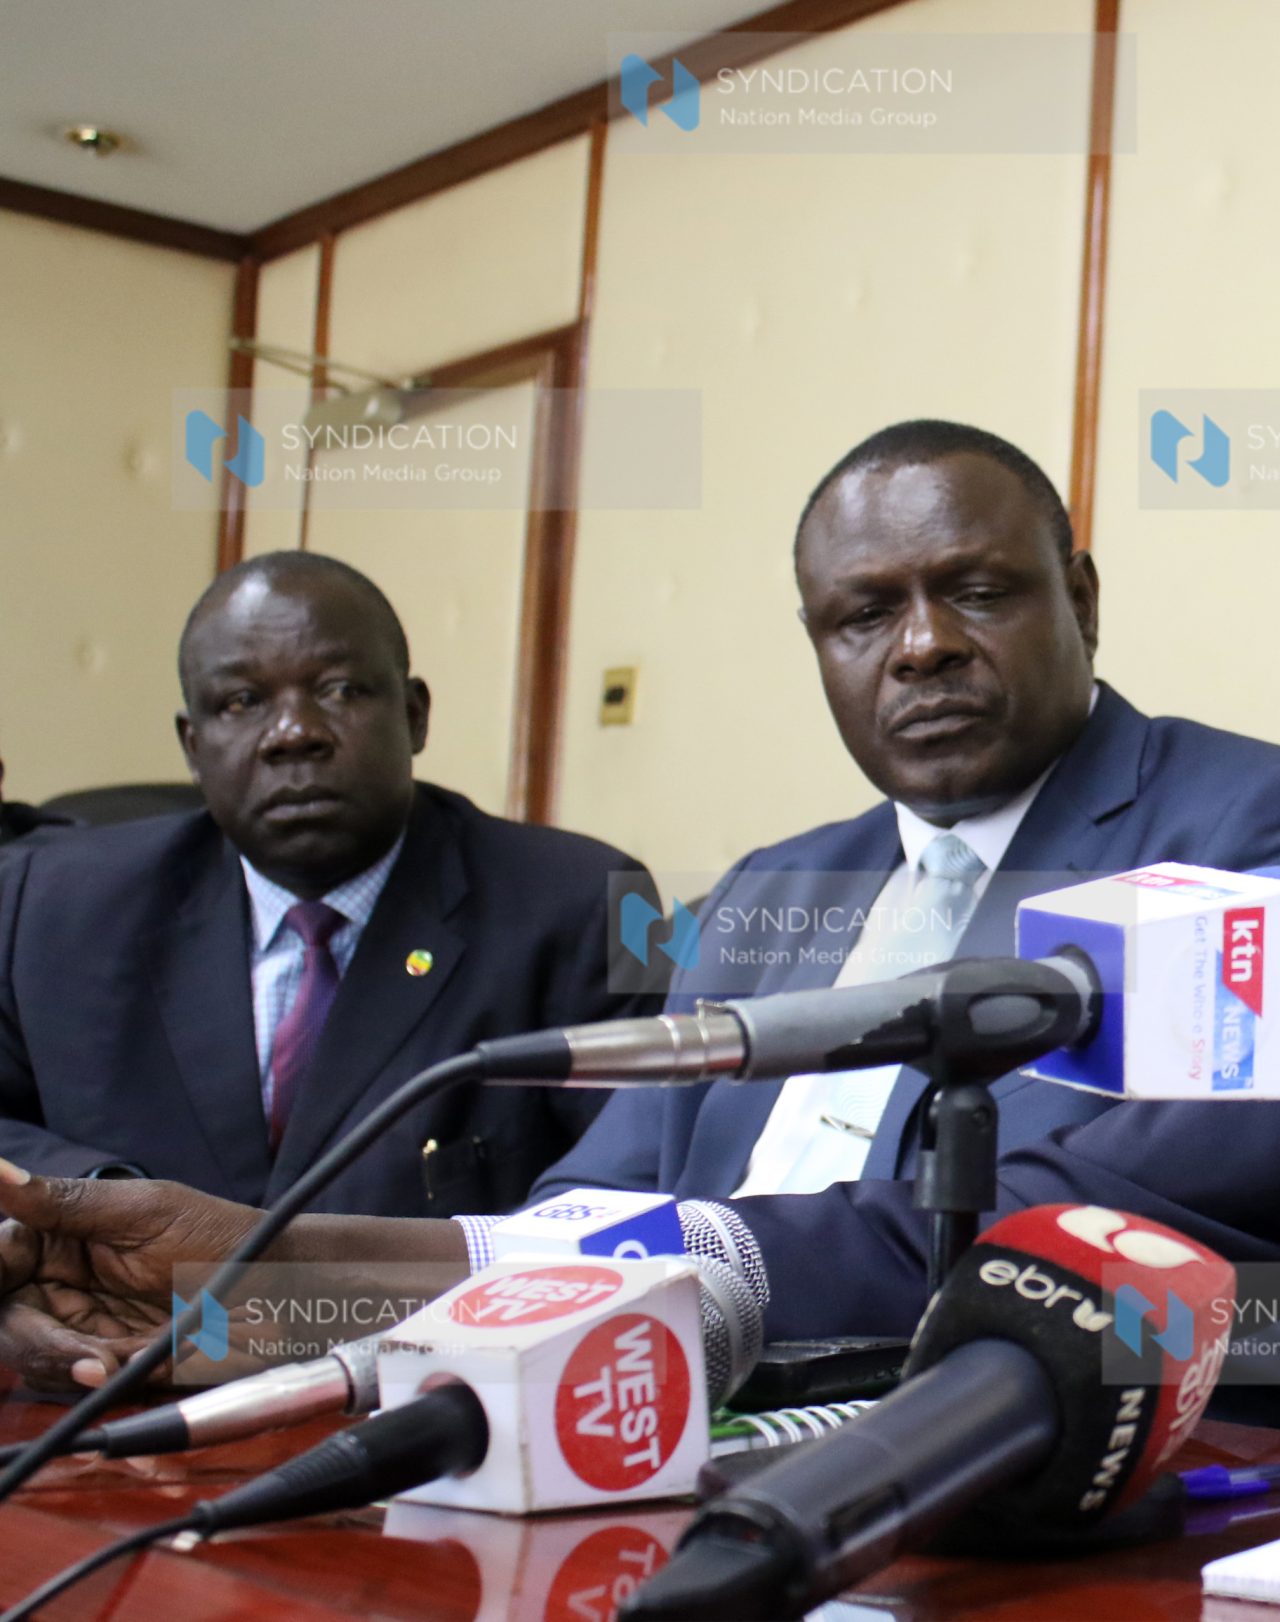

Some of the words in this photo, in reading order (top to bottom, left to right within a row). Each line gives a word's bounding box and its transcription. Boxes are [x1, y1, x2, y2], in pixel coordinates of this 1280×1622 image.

[1195, 915, 1208, 944] Get
[1230, 919, 1261, 983] ktn
[1194, 949, 1208, 980] The
[1191, 983, 1207, 1034] Whoe
[1220, 1003, 1243, 1080] NEWS
[477, 1299, 549, 1321] TV
[485, 1274, 618, 1304] WEST
[978, 1258, 1116, 1333] ebru
[572, 1366, 615, 1438] TV
[612, 1320, 663, 1471] WEST
[1079, 1386, 1148, 1512] NEWS
